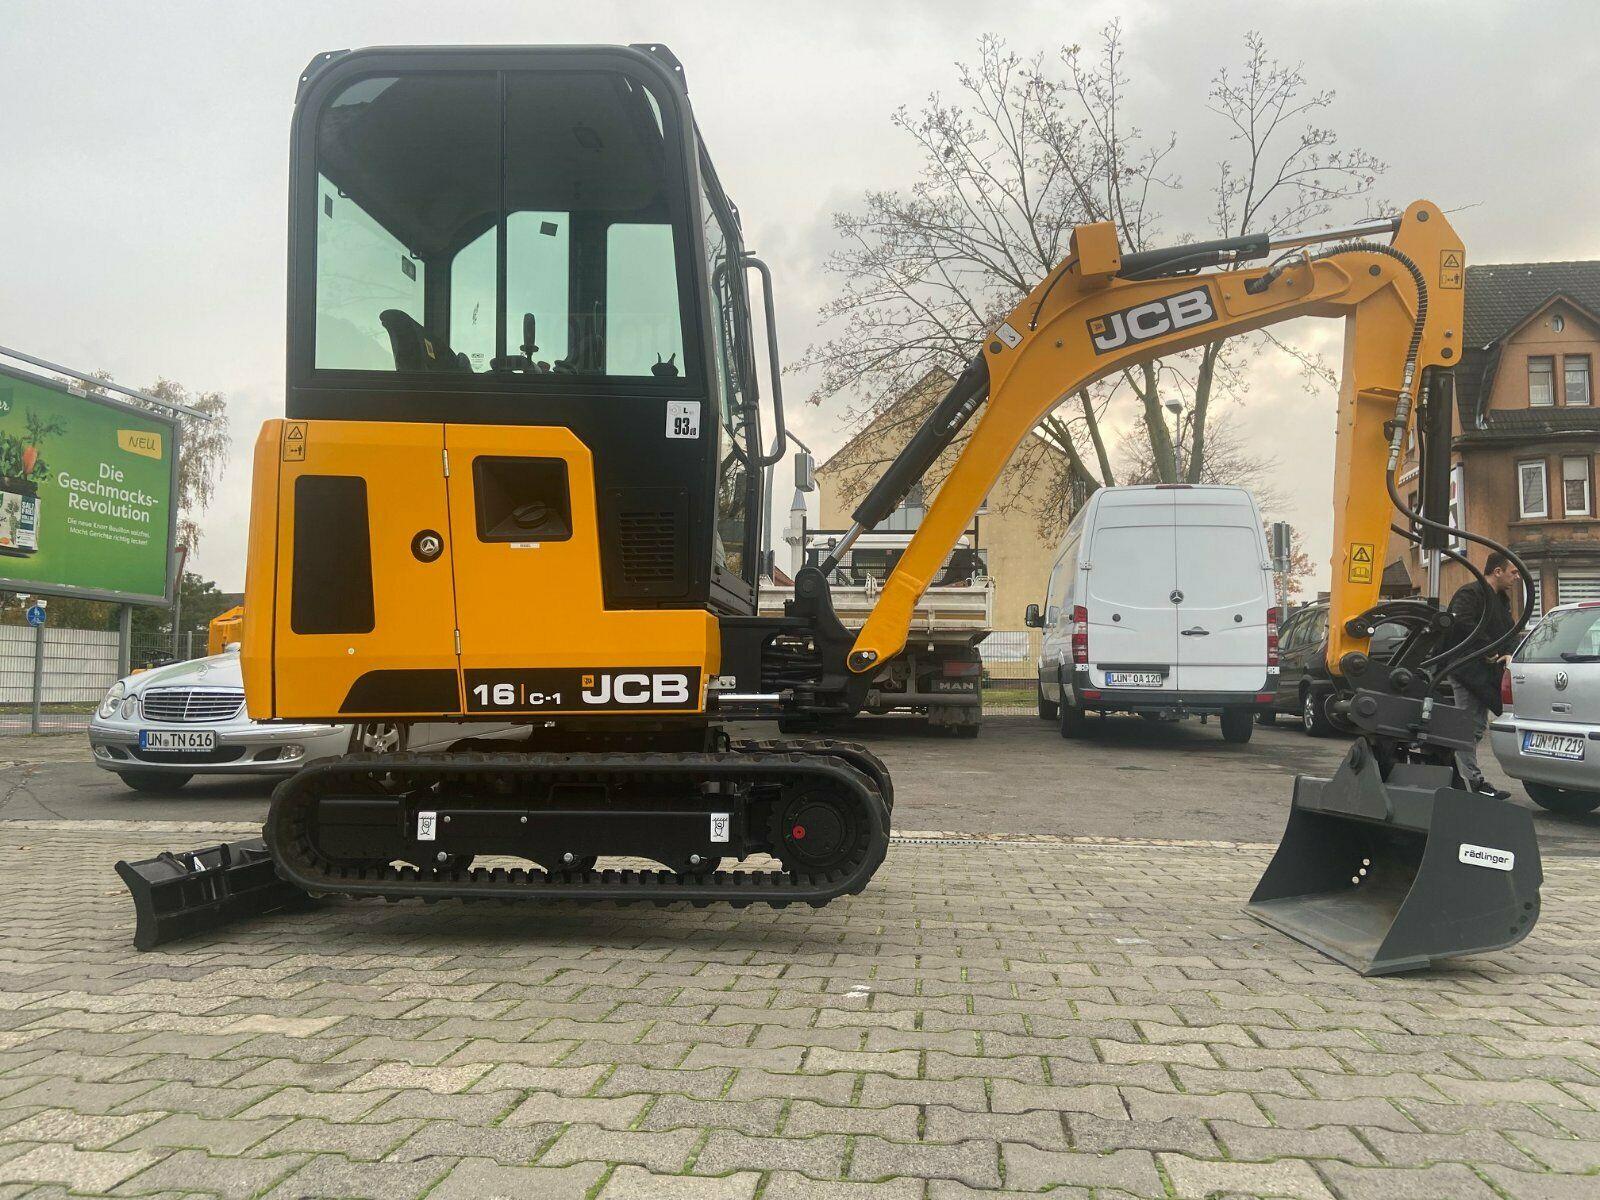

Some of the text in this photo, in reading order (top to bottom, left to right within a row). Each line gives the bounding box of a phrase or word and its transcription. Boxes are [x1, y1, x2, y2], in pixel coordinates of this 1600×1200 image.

[1093, 290, 1213, 350] JCB
[128, 436, 156, 451] NEU
[99, 462, 124, 482] Die
[57, 472, 159, 507] Geschmacks-
[68, 492, 150, 523] Revolution
[939, 682, 974, 690] MAN
[1146, 674, 1161, 684] 120
[473, 683, 515, 706] 16
[581, 674, 689, 704] JCB
[147, 733, 212, 747] UN TN 616
[1551, 736, 1565, 750] RT
[1565, 738, 1584, 753] 219
[1464, 850, 1510, 864] rädlinger
